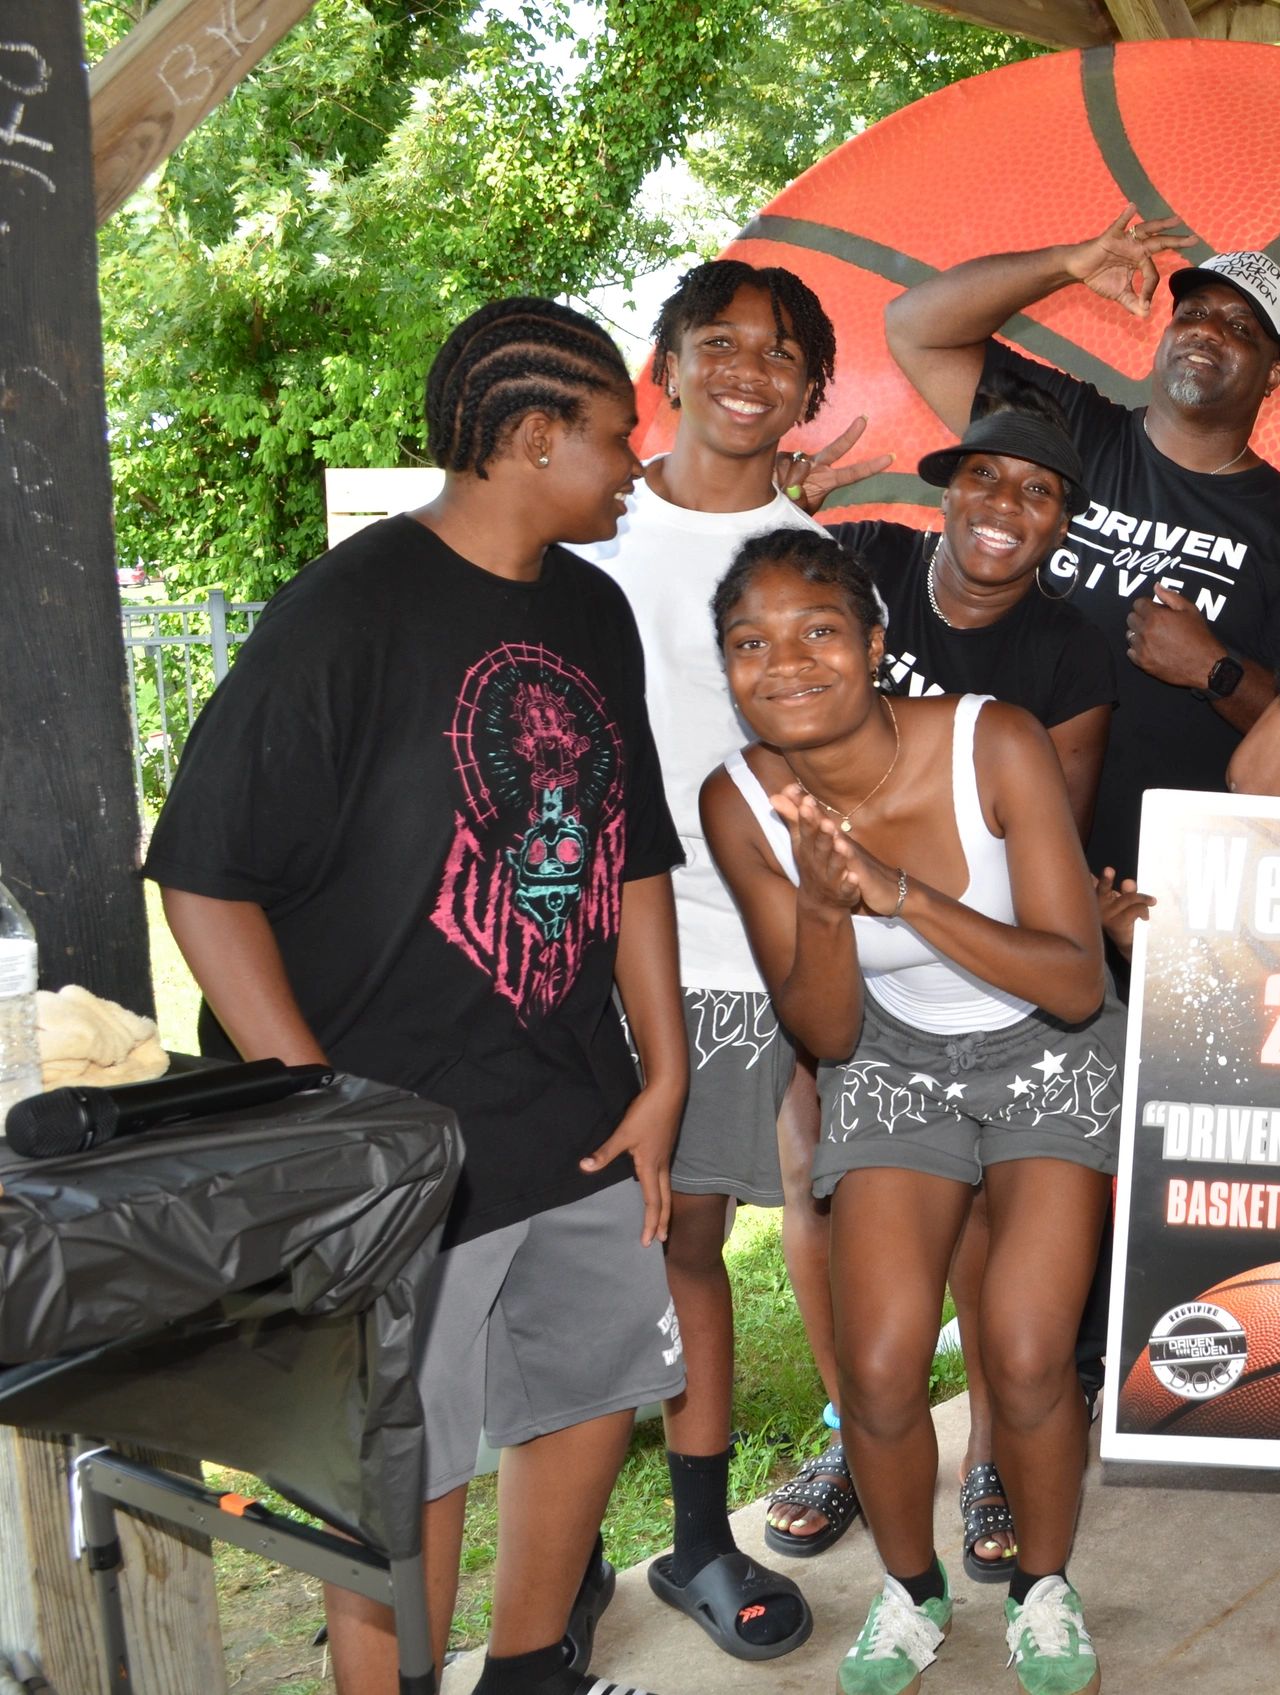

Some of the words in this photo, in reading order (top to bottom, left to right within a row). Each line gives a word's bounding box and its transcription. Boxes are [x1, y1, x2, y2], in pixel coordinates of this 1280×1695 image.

[1230, 258, 1267, 281] OVER
[1071, 500, 1248, 570] DRIVEN
[1112, 546, 1182, 575] over
[1168, 1336, 1215, 1351] DRIVEN
[1190, 1344, 1228, 1359] GIVEN
